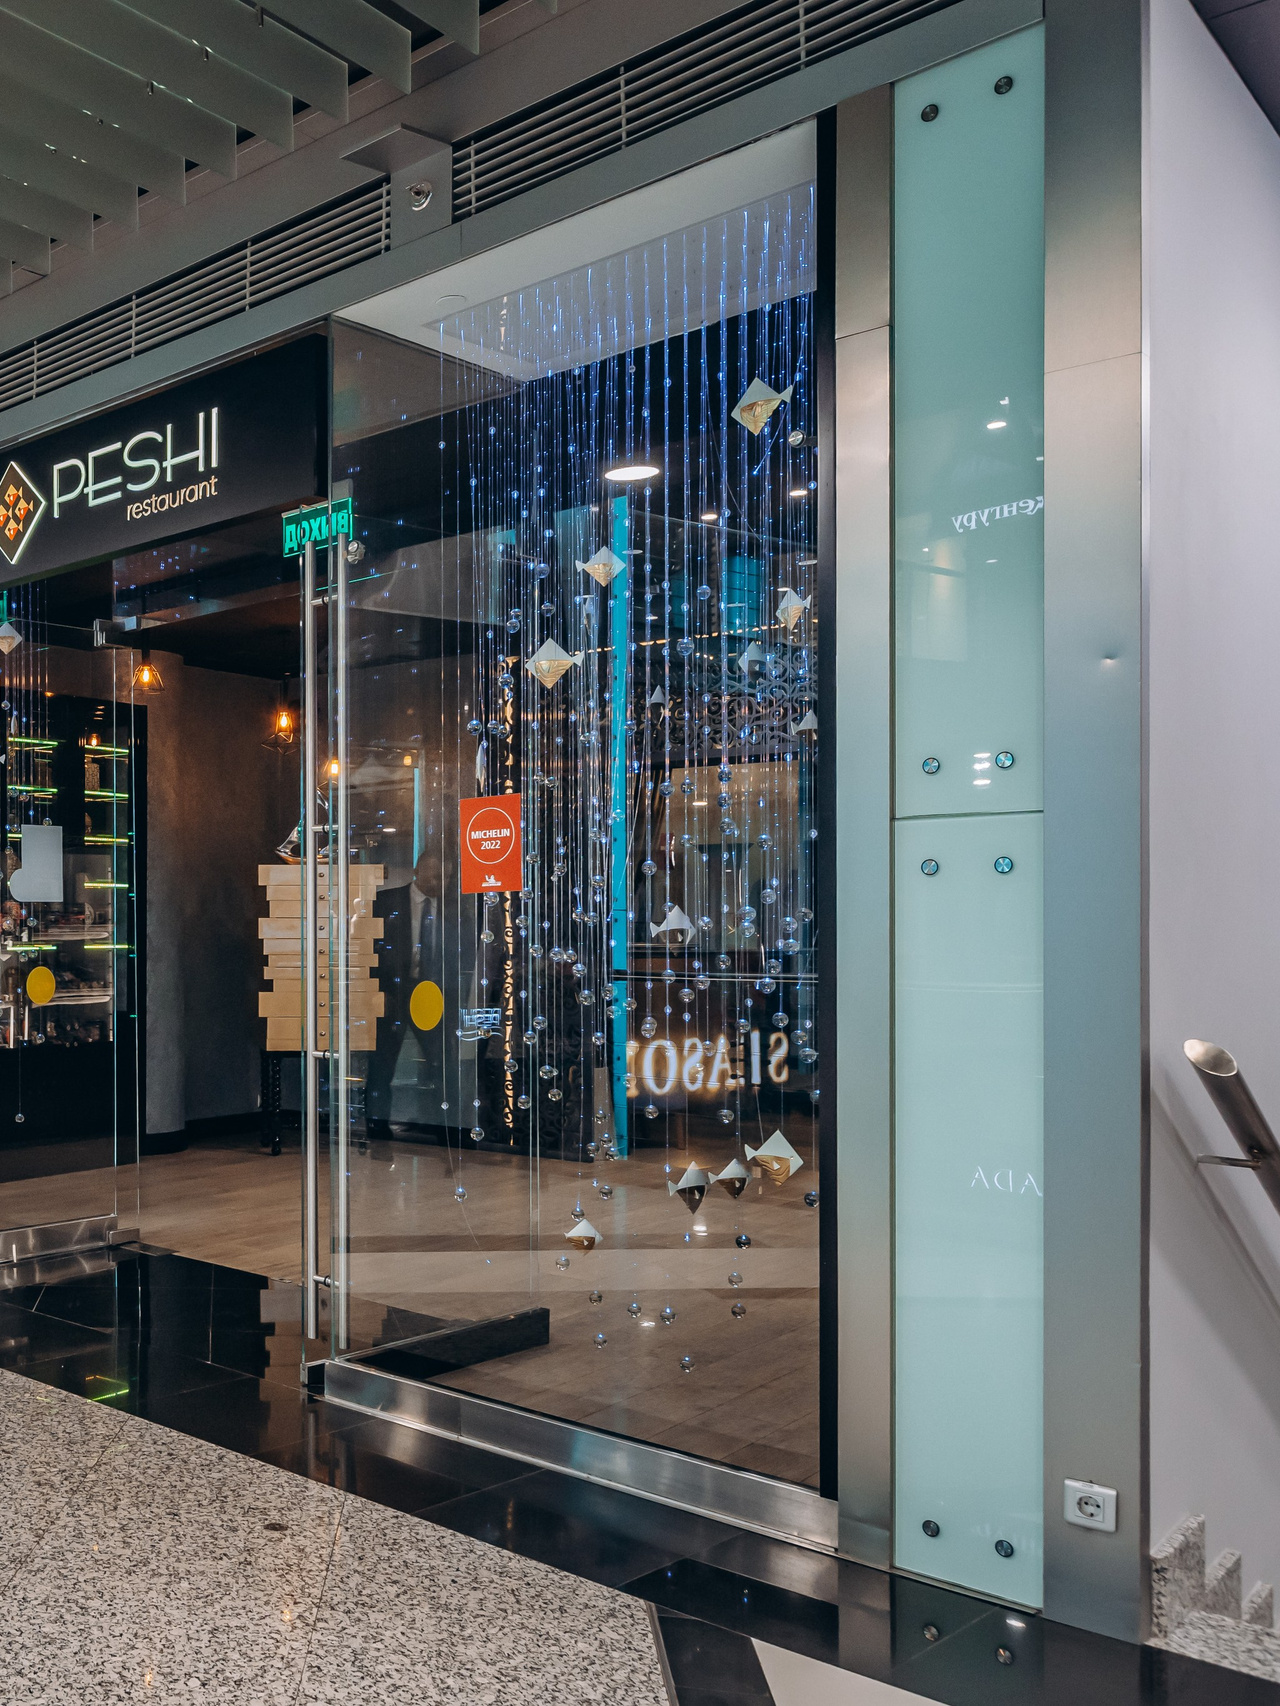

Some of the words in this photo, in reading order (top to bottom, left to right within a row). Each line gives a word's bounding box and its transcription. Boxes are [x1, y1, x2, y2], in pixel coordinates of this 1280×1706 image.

[52, 406, 219, 519] PESHI
[127, 475, 218, 521] restaurant
[471, 828, 510, 840] MICHELIN
[480, 840, 501, 850] 2022
